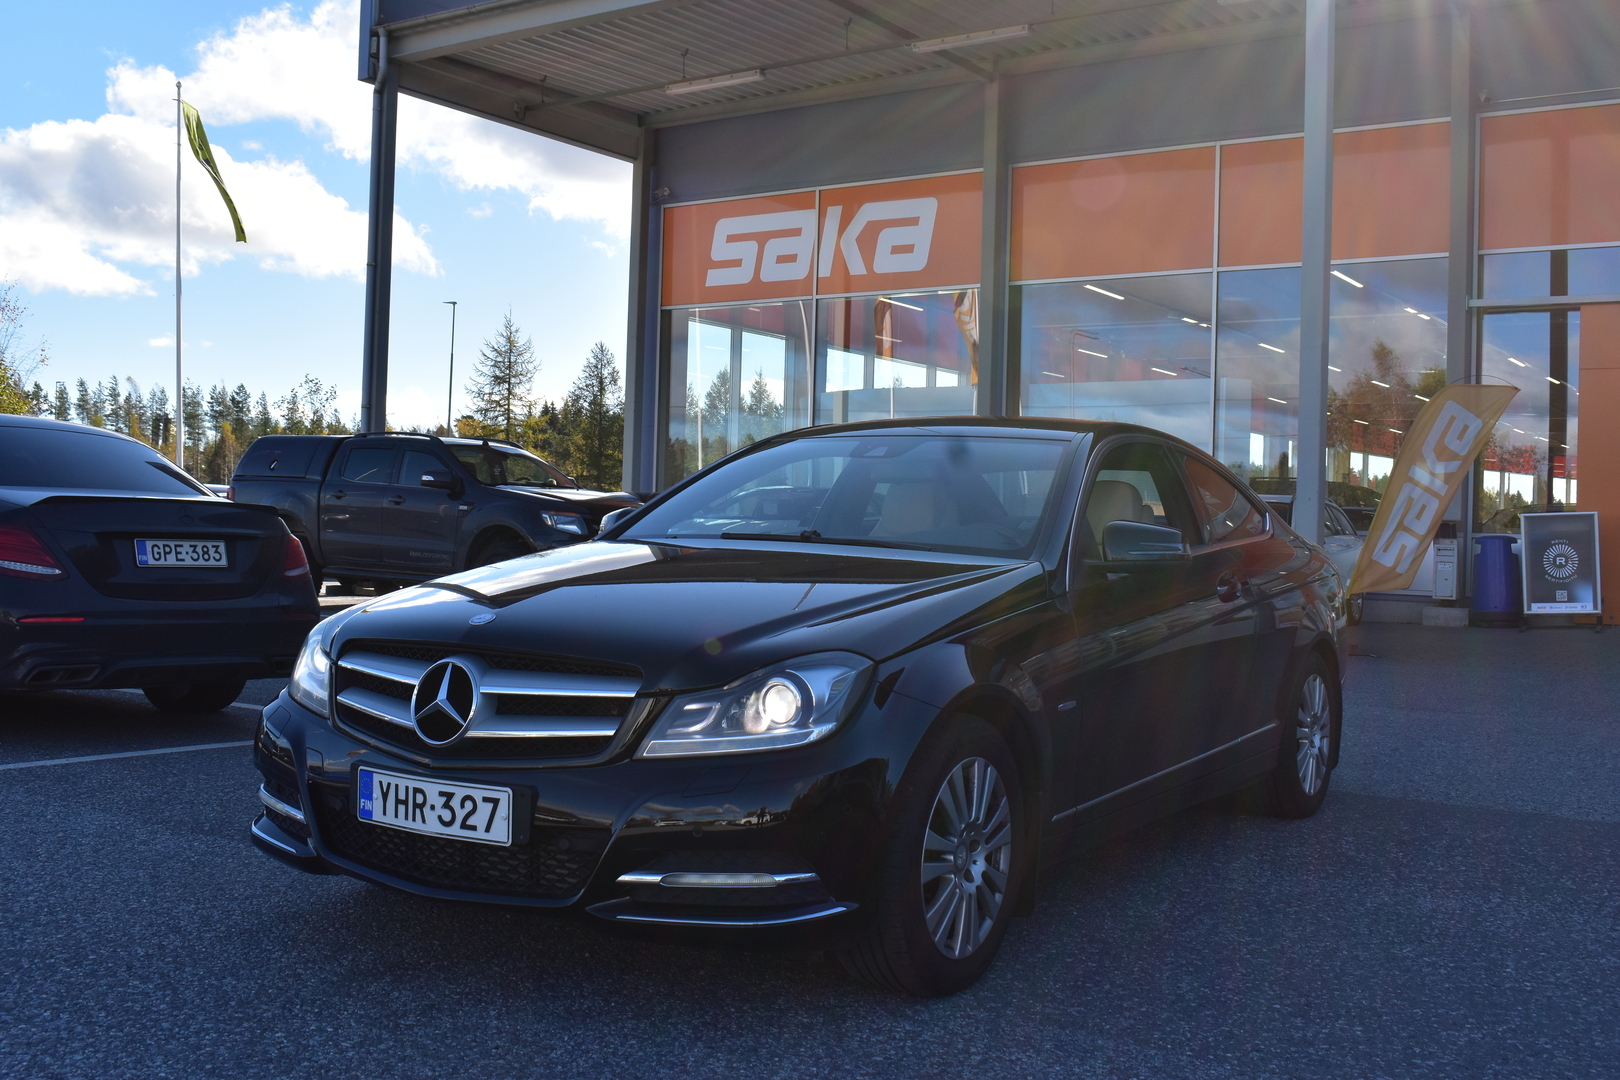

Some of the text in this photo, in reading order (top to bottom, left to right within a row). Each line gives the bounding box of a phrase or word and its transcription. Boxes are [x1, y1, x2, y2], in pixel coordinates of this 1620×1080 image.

[151, 543, 223, 562] GPE-383
[360, 780, 501, 833] FIN YHR-327
